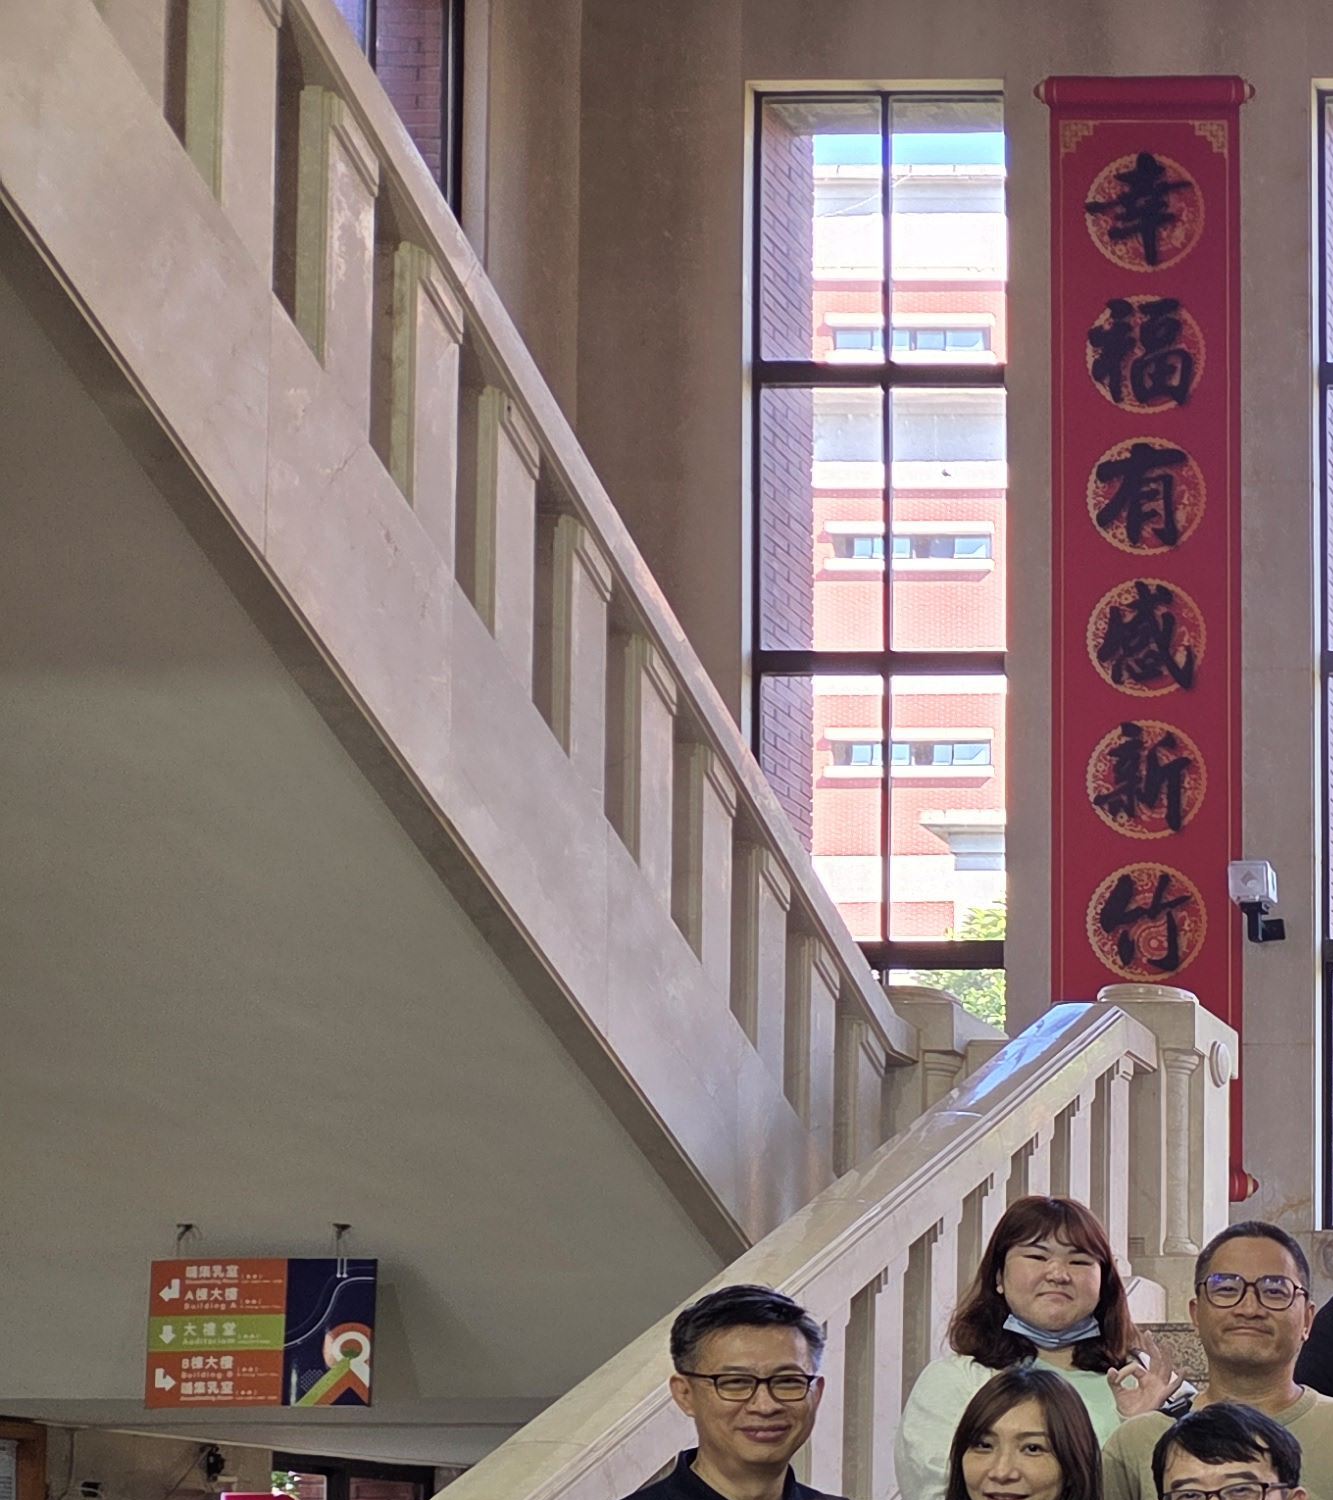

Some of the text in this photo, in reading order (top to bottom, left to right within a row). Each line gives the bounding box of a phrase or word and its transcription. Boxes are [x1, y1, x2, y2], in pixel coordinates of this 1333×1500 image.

[1084, 151, 1195, 974] 幸福有感新竹
